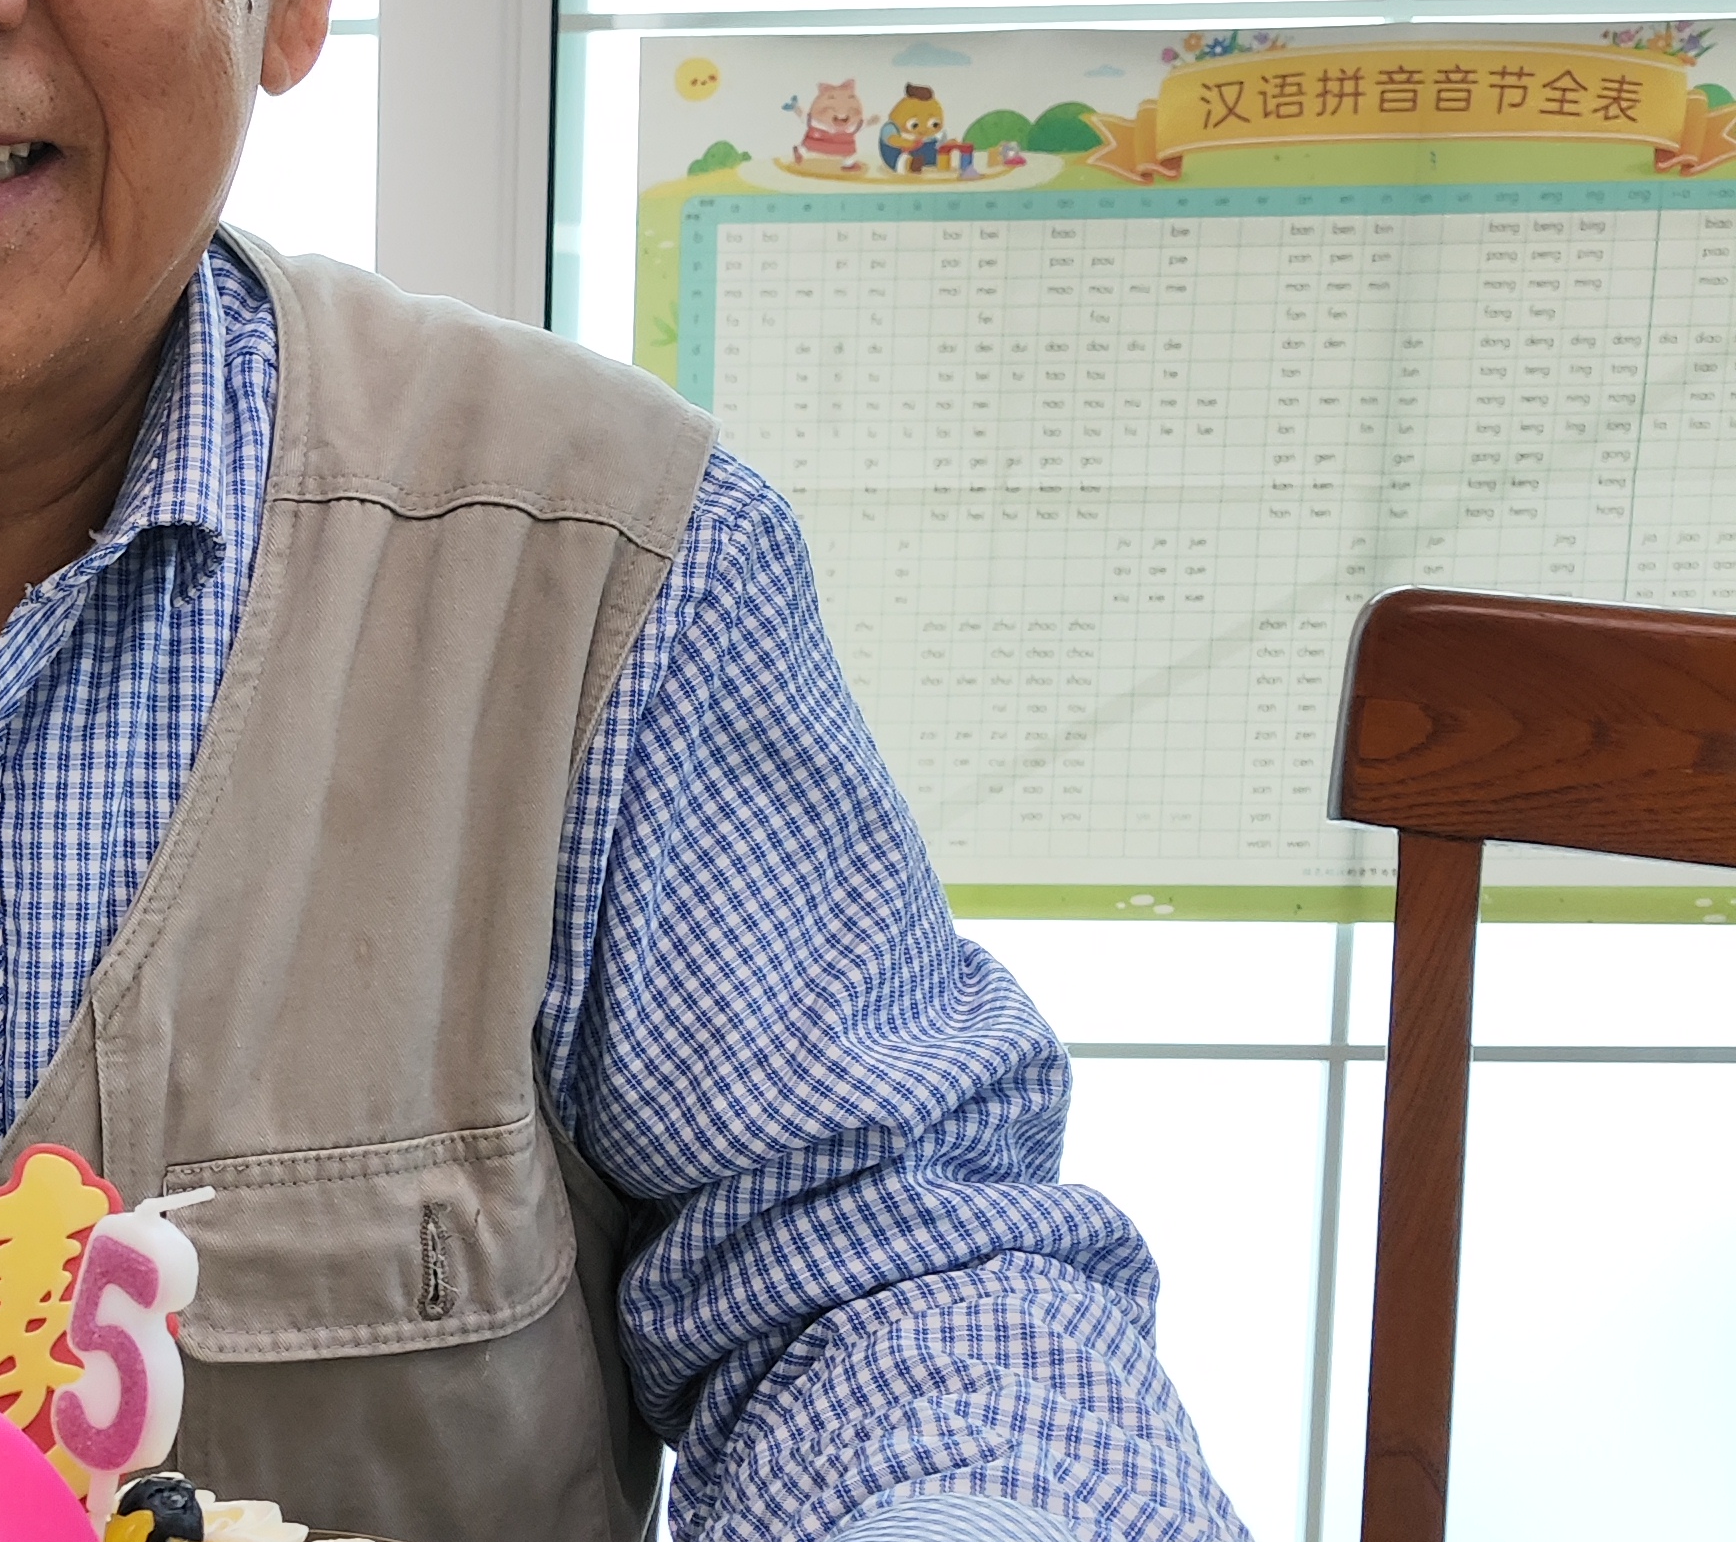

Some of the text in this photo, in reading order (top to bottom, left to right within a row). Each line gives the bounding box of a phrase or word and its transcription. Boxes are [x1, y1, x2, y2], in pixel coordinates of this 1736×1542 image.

[1198, 64, 1644, 129] 汉语拼音音节全表
